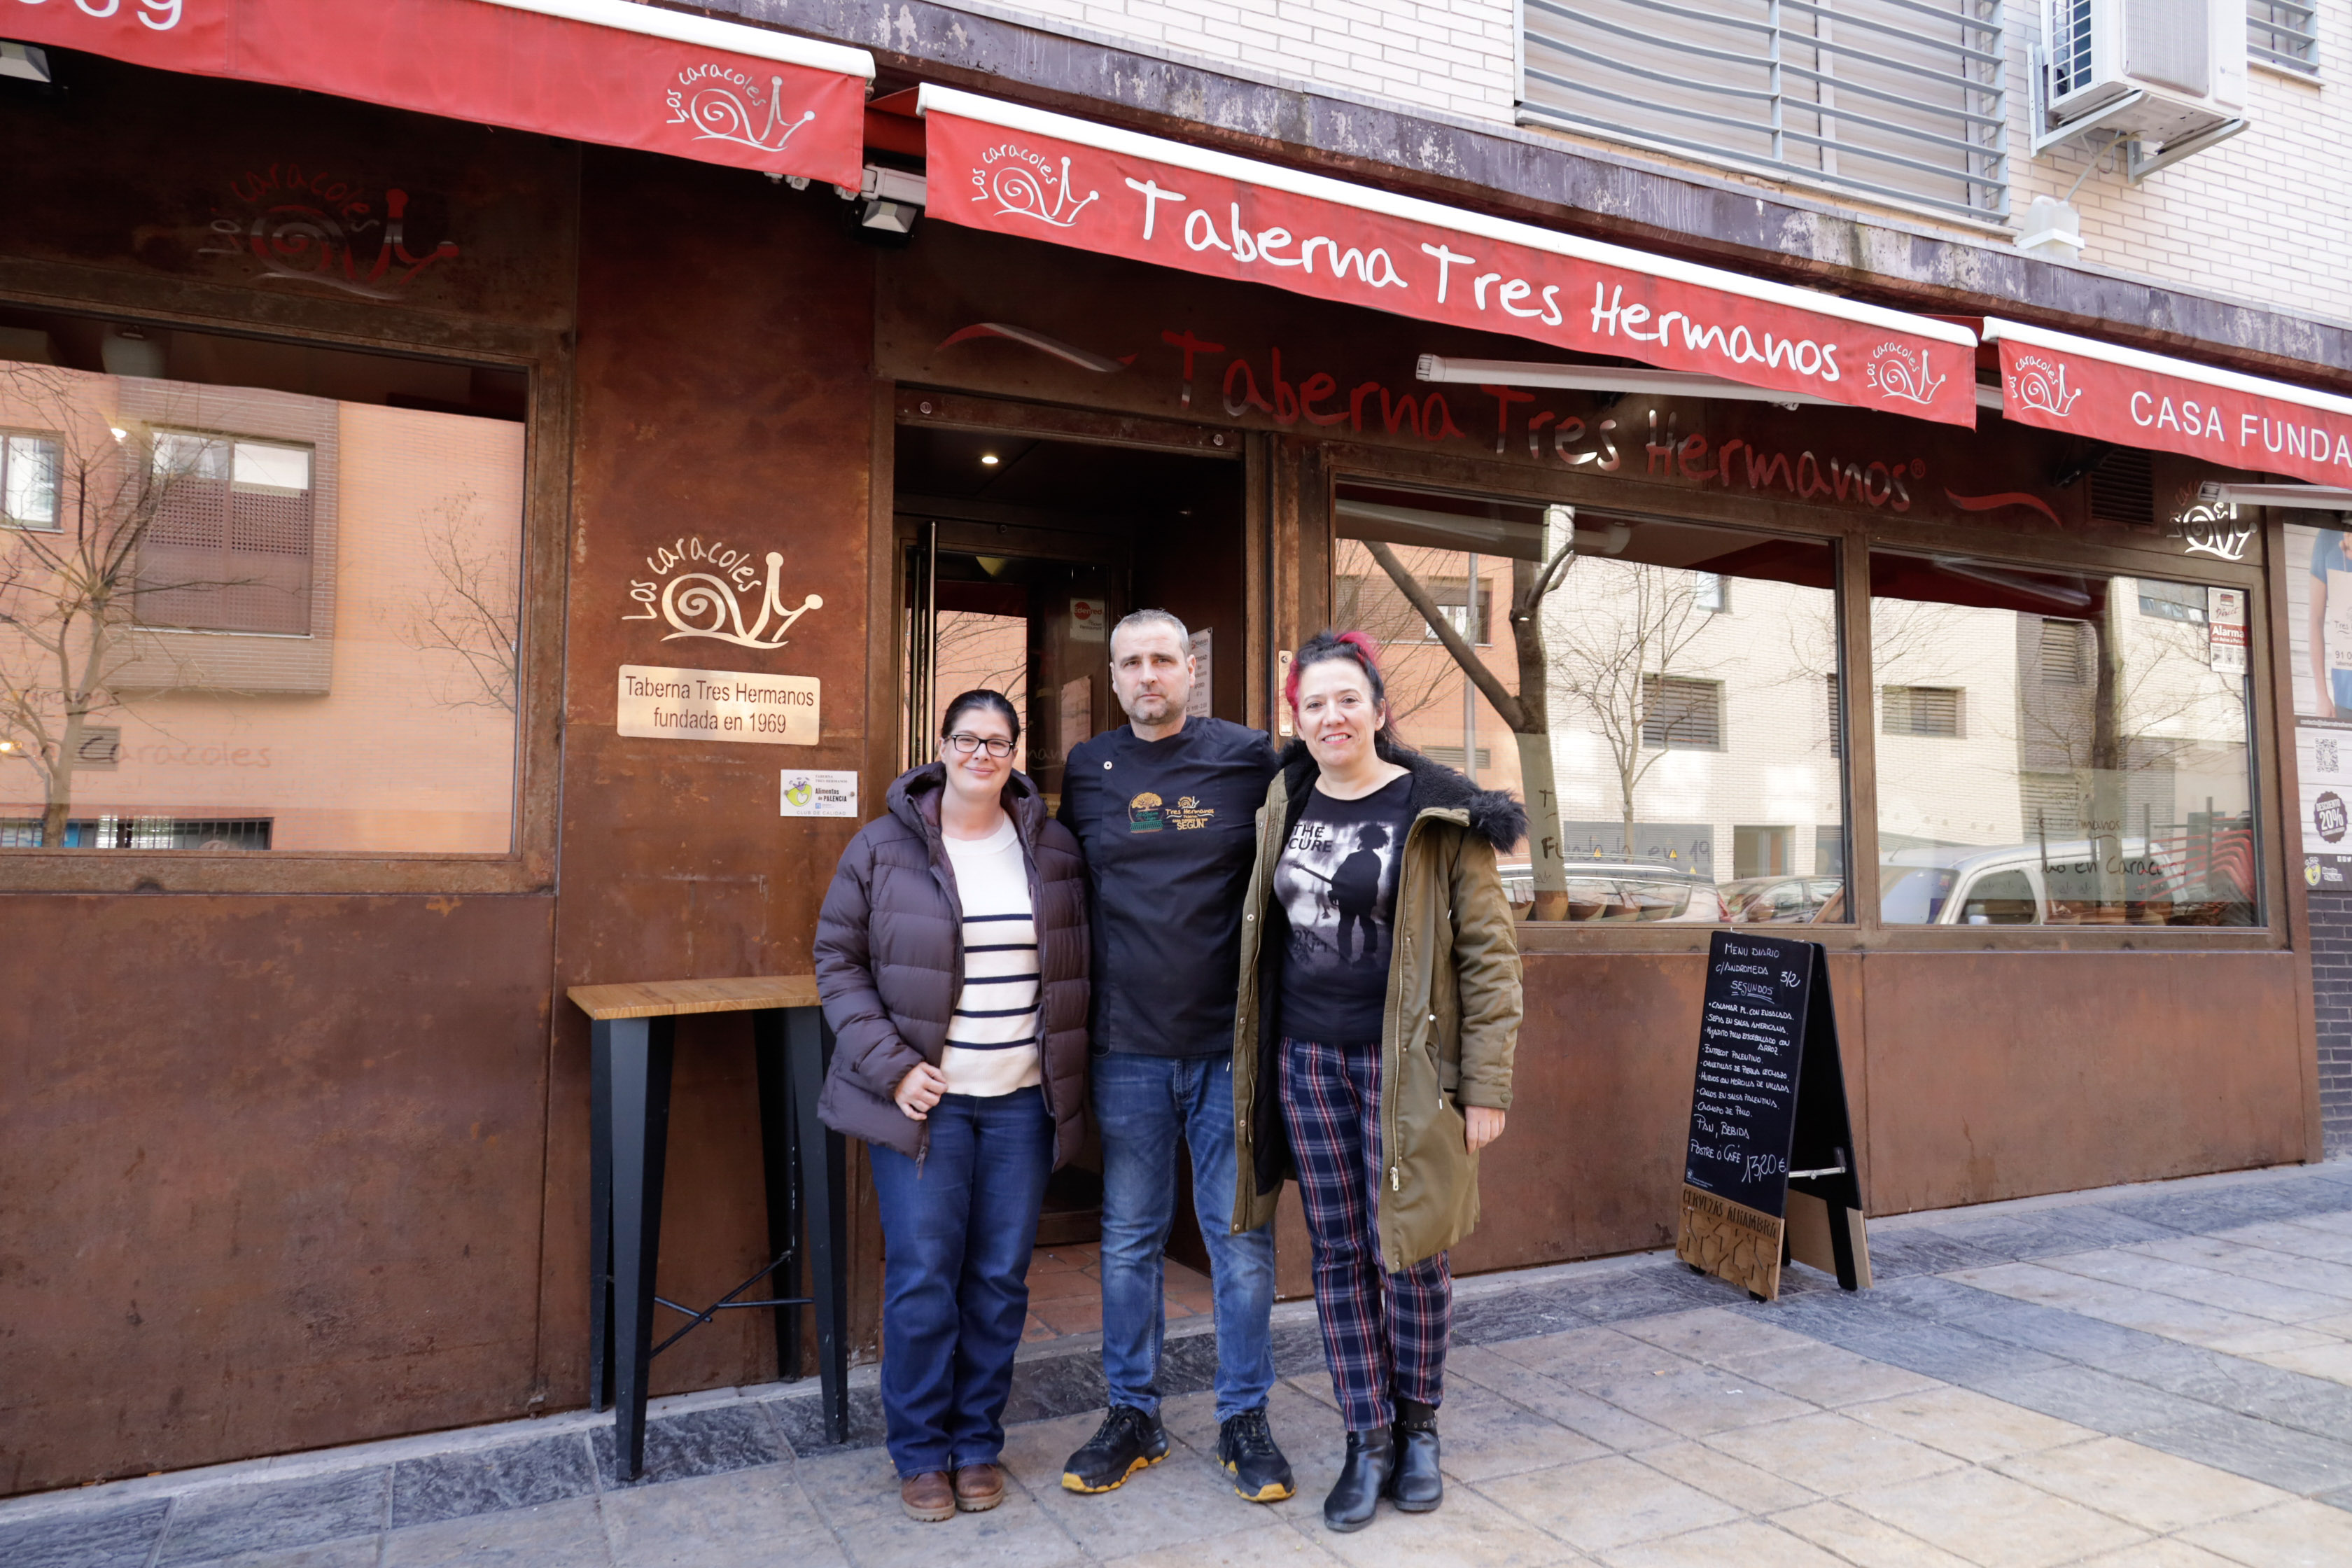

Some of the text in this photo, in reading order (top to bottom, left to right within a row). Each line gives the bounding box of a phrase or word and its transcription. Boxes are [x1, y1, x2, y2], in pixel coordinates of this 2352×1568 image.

[666, 64, 766, 123] Los caracoles
[972, 144, 1058, 201] Los caracoles
[230, 162, 380, 232] caracoles
[1125, 176, 1840, 382] Taberna Tres Hermanos
[1867, 342, 1920, 388] Los caracoles
[2008, 356, 2059, 398] Los caracoles
[1161, 328, 1466, 442] Taberna
[1479, 383, 1621, 472] Tres
[2130, 391, 2352, 468] CASA FUNDA
[622, 537, 762, 620] Los caracoles
[1074, 607, 1103, 615] Edenred
[2212, 625, 2244, 638] Alarma
[626, 676, 814, 706] Taberna Tres Hermanos
[654, 707, 786, 734] fundada en 1969
[78, 736, 274, 768] Caracoles
[2319, 807, 2344, 831] 20%
[1294, 824, 1325, 838] THE
[1288, 837, 1333, 853] CURE
[2075, 862, 2097, 874] en
[1725, 943, 1779, 958] MENU DIARIO
[1712, 1001, 1737, 1012] CALAMAR
[1707, 1014, 1725, 1024] SEPIA
[1734, 1018, 1750, 1028] SALSA
[1729, 1030, 1742, 1040] POLLO
[1704, 1043, 1729, 1058] ENTRECOT
[1701, 1071, 1719, 1082] HUEVOS
[1730, 1078, 1755, 1088] MORCILLA
[1700, 1087, 1717, 1098] CALLOS
[1727, 1093, 1743, 1101] SALSA
[1698, 1102, 1724, 1114] CACHOPO
[1726, 1107, 1733, 1115] DE
[1721, 1121, 1749, 1140] BEBIDA
[1690, 1139, 1714, 1158] POSTRE
[1742, 1154, 1777, 1184] 13,20
[1683, 1189, 1777, 1239] CERVEZAS ALHAMBRA
